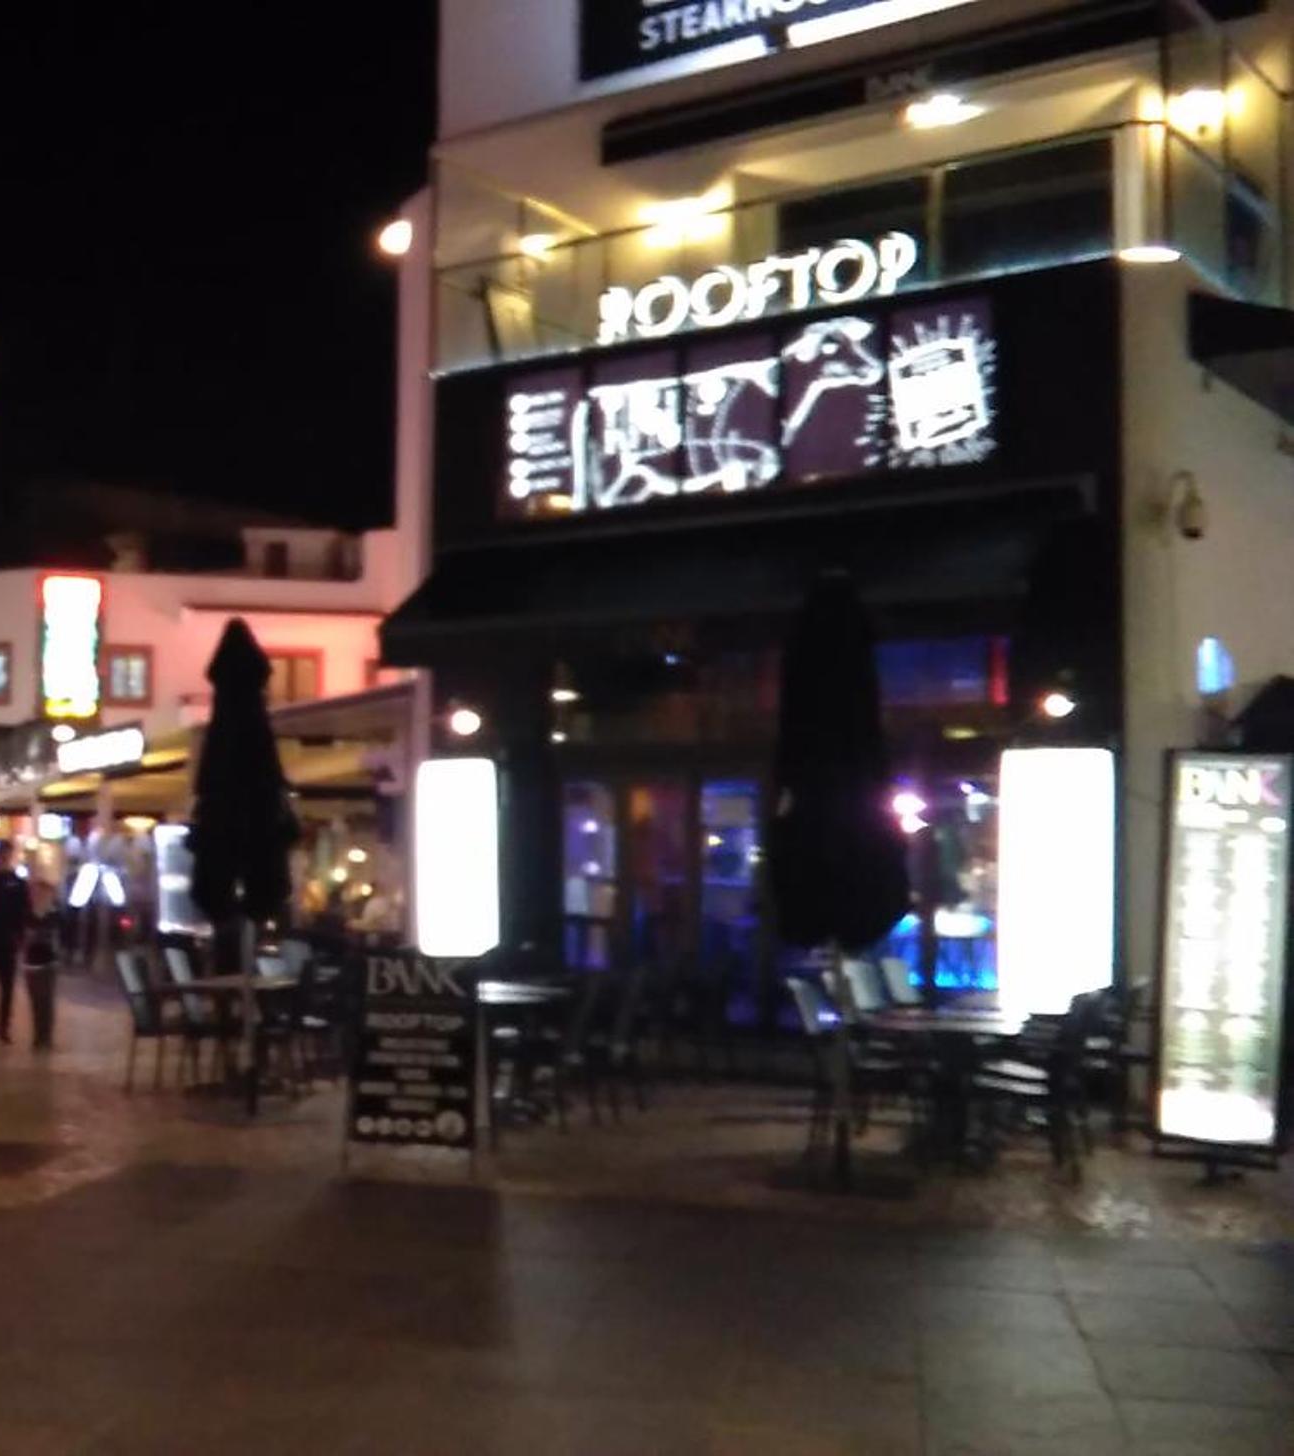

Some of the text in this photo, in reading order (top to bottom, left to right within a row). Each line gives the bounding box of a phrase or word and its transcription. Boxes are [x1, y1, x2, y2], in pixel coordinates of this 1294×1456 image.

[639, 0, 828, 50] STEAKH
[596, 230, 918, 346] ROOFTOP
[1180, 766, 1283, 806] BANK
[367, 957, 468, 997] BANK
